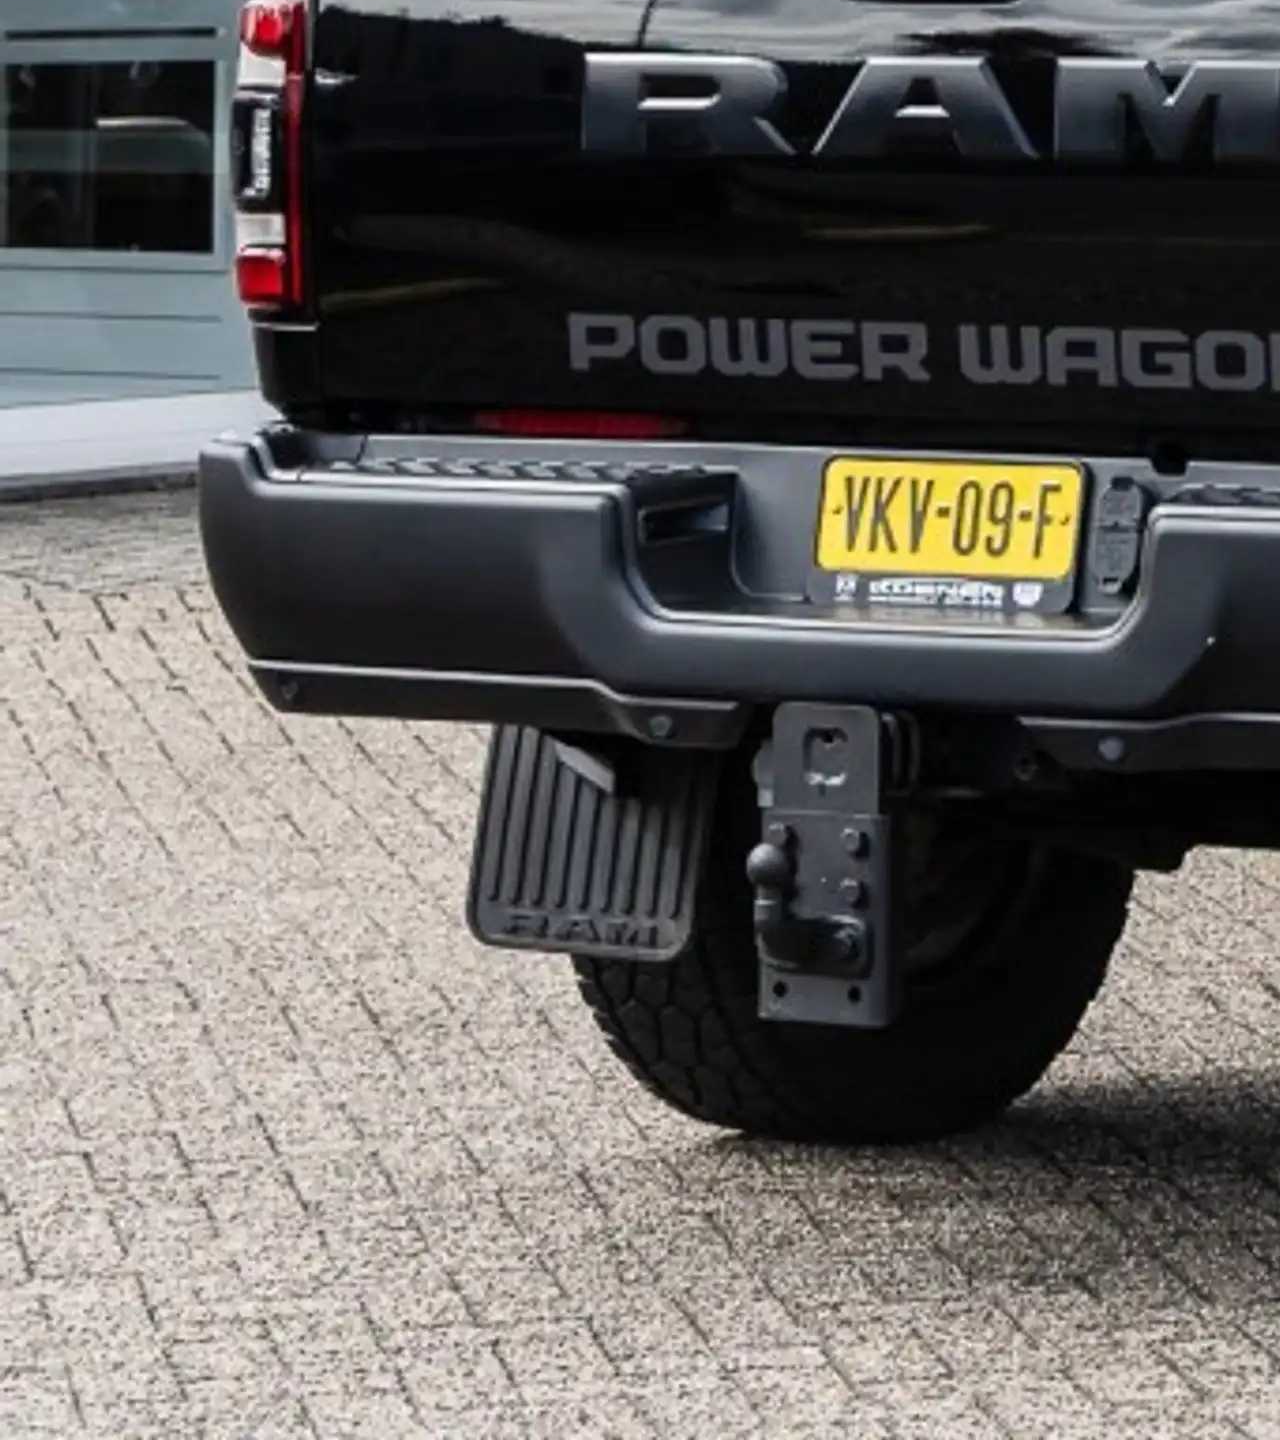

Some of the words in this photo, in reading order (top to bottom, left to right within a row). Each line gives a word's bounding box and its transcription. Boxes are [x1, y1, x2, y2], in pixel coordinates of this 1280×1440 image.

[567, 312, 930, 383] POWER
[843, 474, 1064, 560] VKV-09-F
[502, 908, 658, 948] RAM
